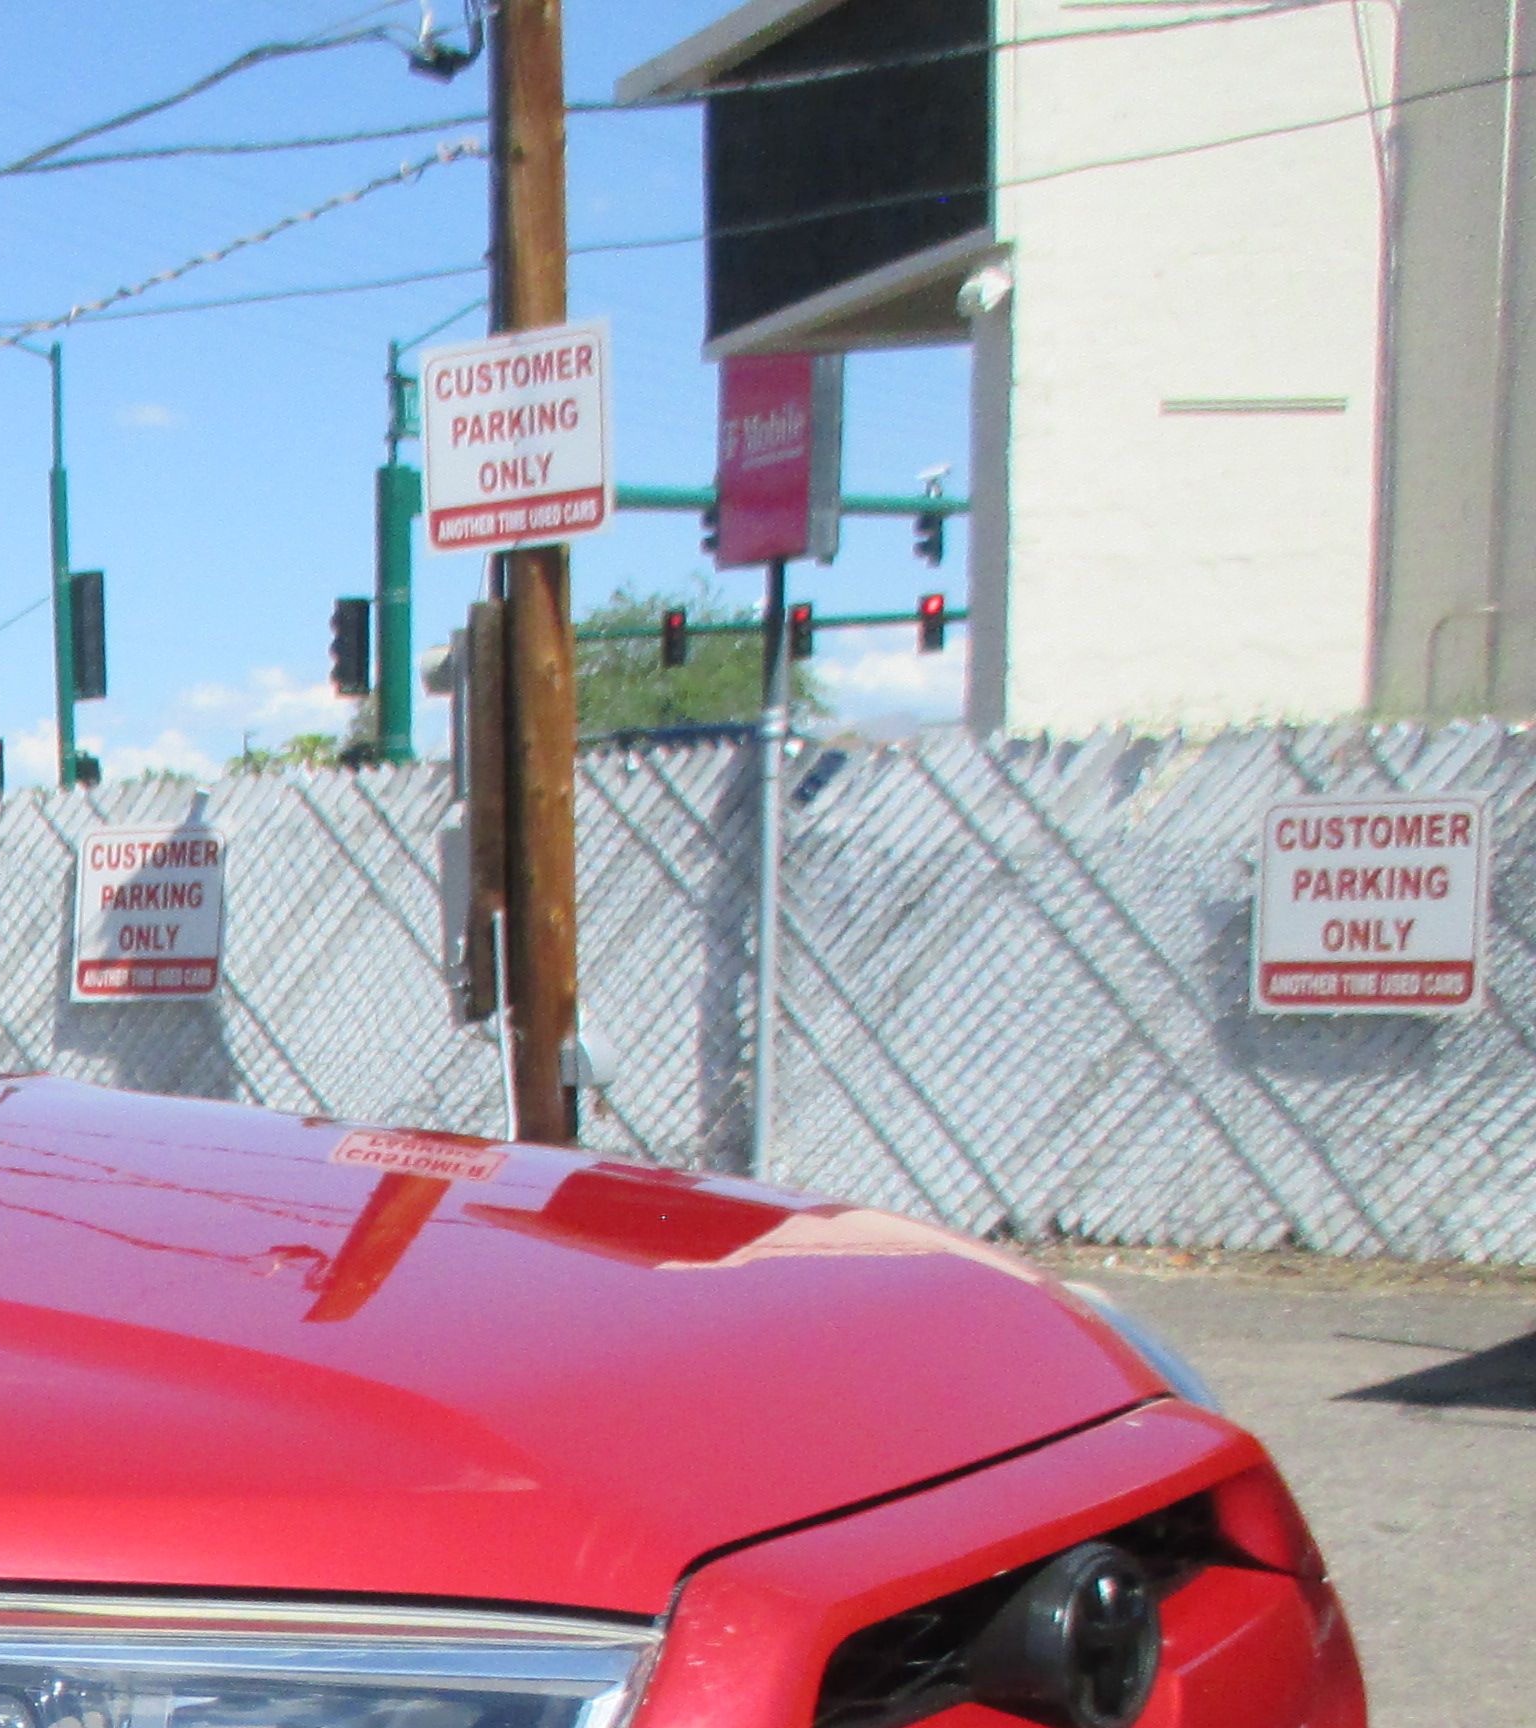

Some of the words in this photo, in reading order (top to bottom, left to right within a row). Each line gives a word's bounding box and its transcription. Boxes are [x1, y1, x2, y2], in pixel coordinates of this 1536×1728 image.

[435, 344, 593, 400] CUSTOMER
[451, 398, 579, 447] PARKING
[478, 452, 554, 494] ONLY
[1276, 814, 1471, 851] CUSTOMER
[90, 840, 220, 871] CUSTOMER
[100, 882, 204, 911] PARKING
[1292, 866, 1450, 901] PARKING
[118, 924, 179, 951] ONLY
[1321, 918, 1415, 952] ONLY
